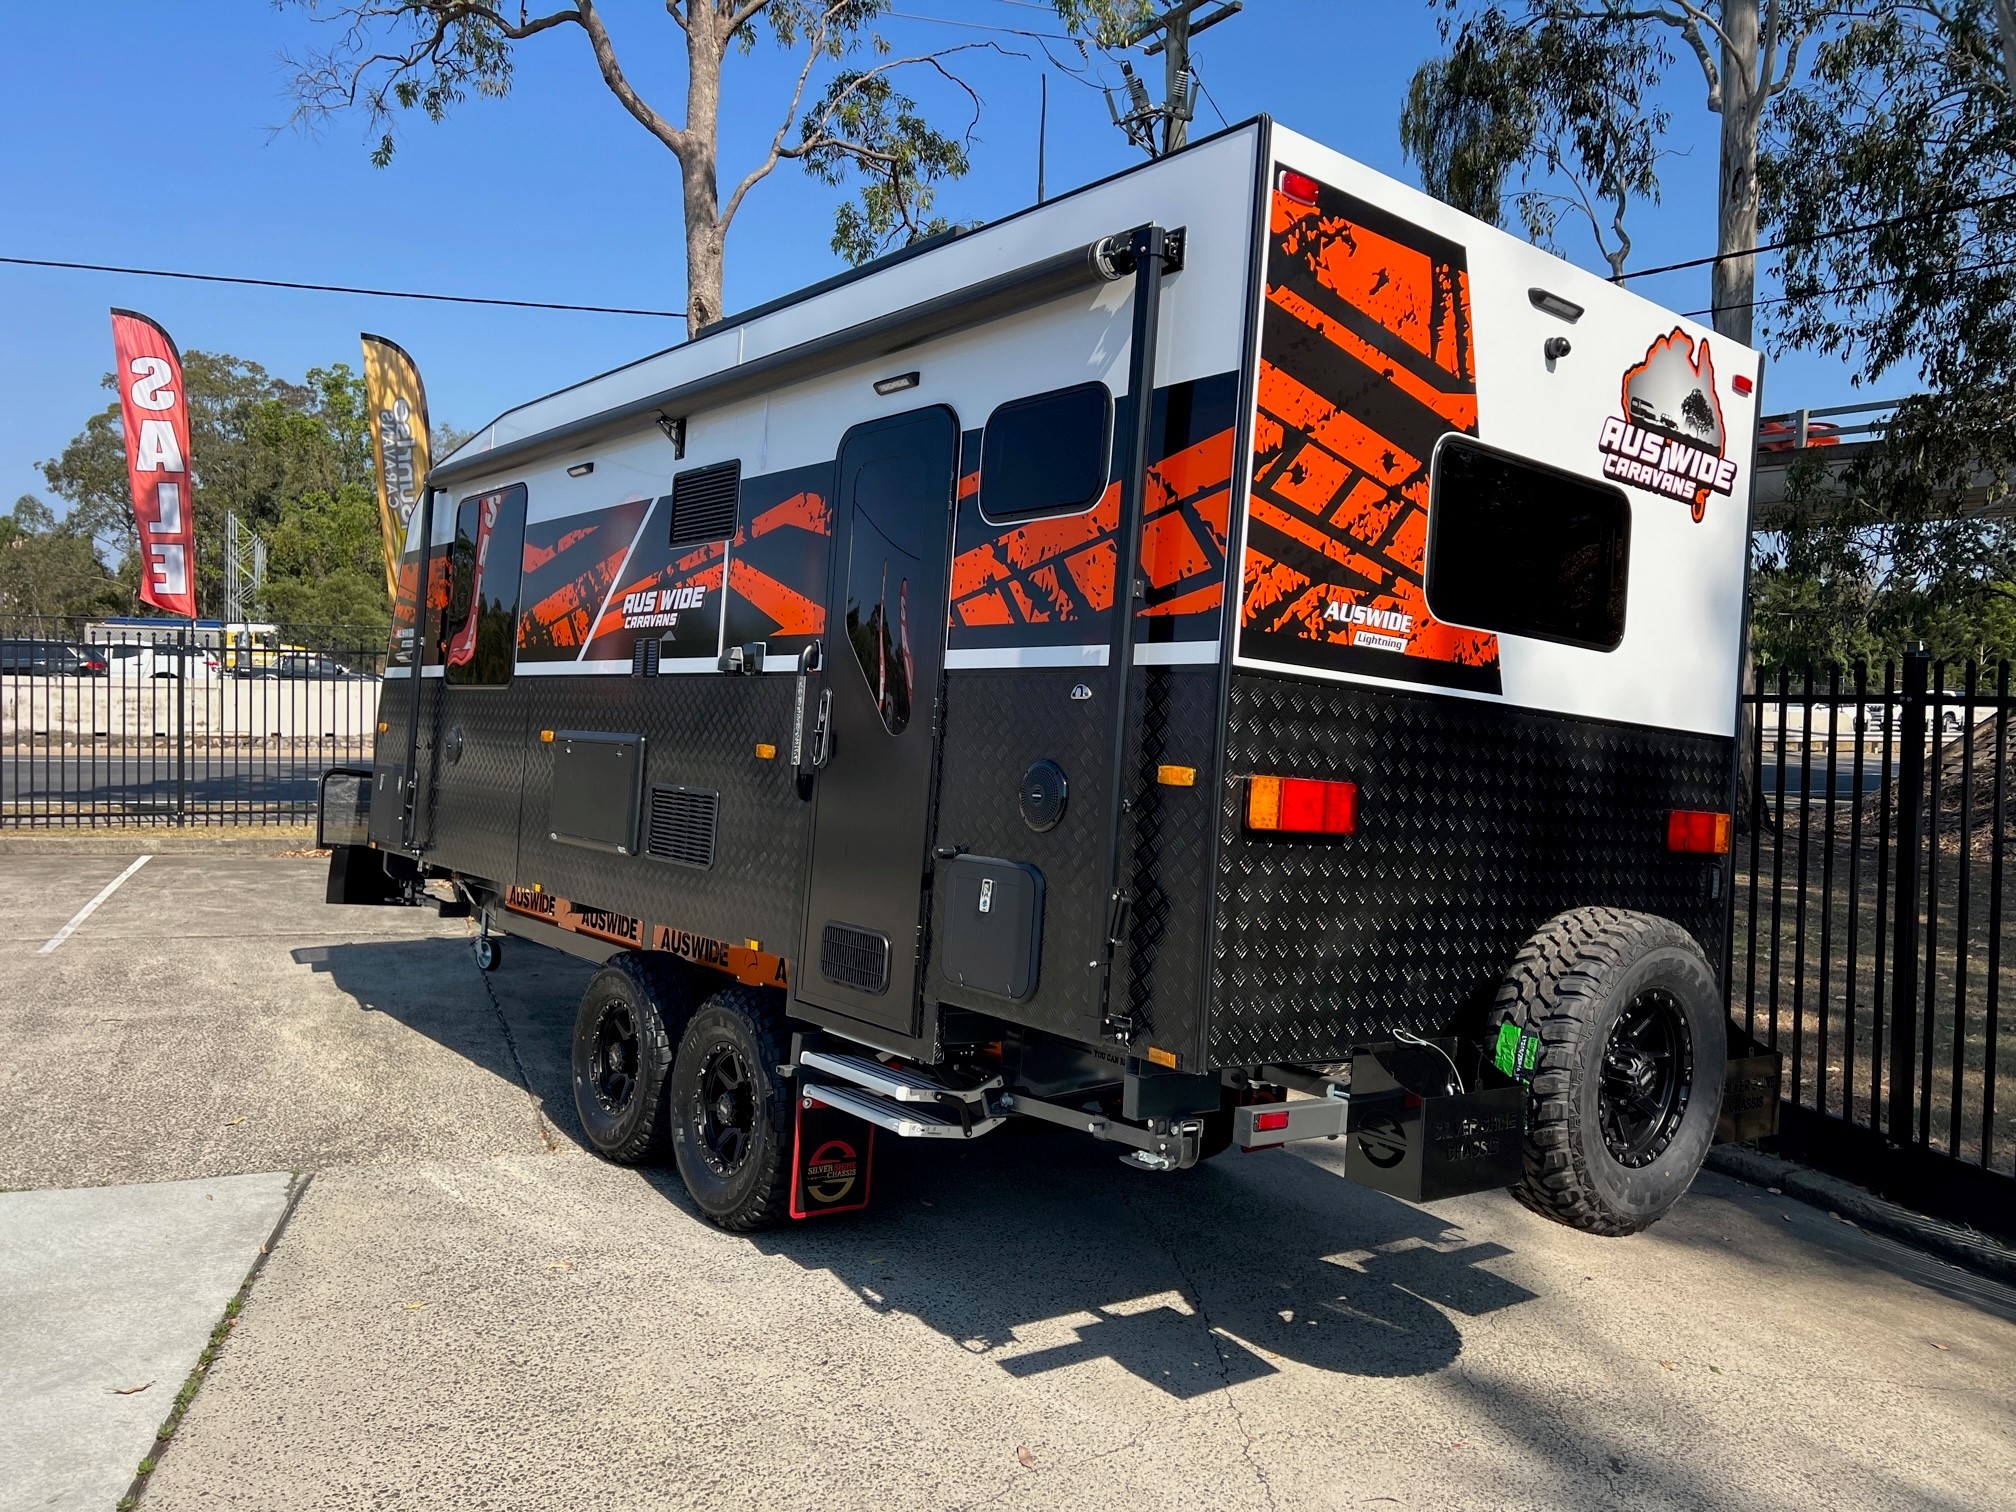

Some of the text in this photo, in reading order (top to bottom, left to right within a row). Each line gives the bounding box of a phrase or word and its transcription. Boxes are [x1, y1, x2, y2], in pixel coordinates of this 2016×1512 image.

[1604, 453, 1697, 500] CARAVANS
[624, 612, 679, 630] CARAVANS
[1323, 600, 1414, 634] AUSWIDE
[1357, 632, 1403, 651] Lightning
[508, 885, 556, 916] AUSWIDE
[581, 911, 639, 941] AUSWIDE
[660, 927, 730, 968] AUSWIDE
[1093, 1049, 1106, 1060] YOU
[1106, 1053, 1120, 1065] CAN
[1446, 1138, 1500, 1161] CHASSIS
[807, 1161, 857, 1176] SILVER SHINE
[826, 1168, 857, 1179] CHASSIS
